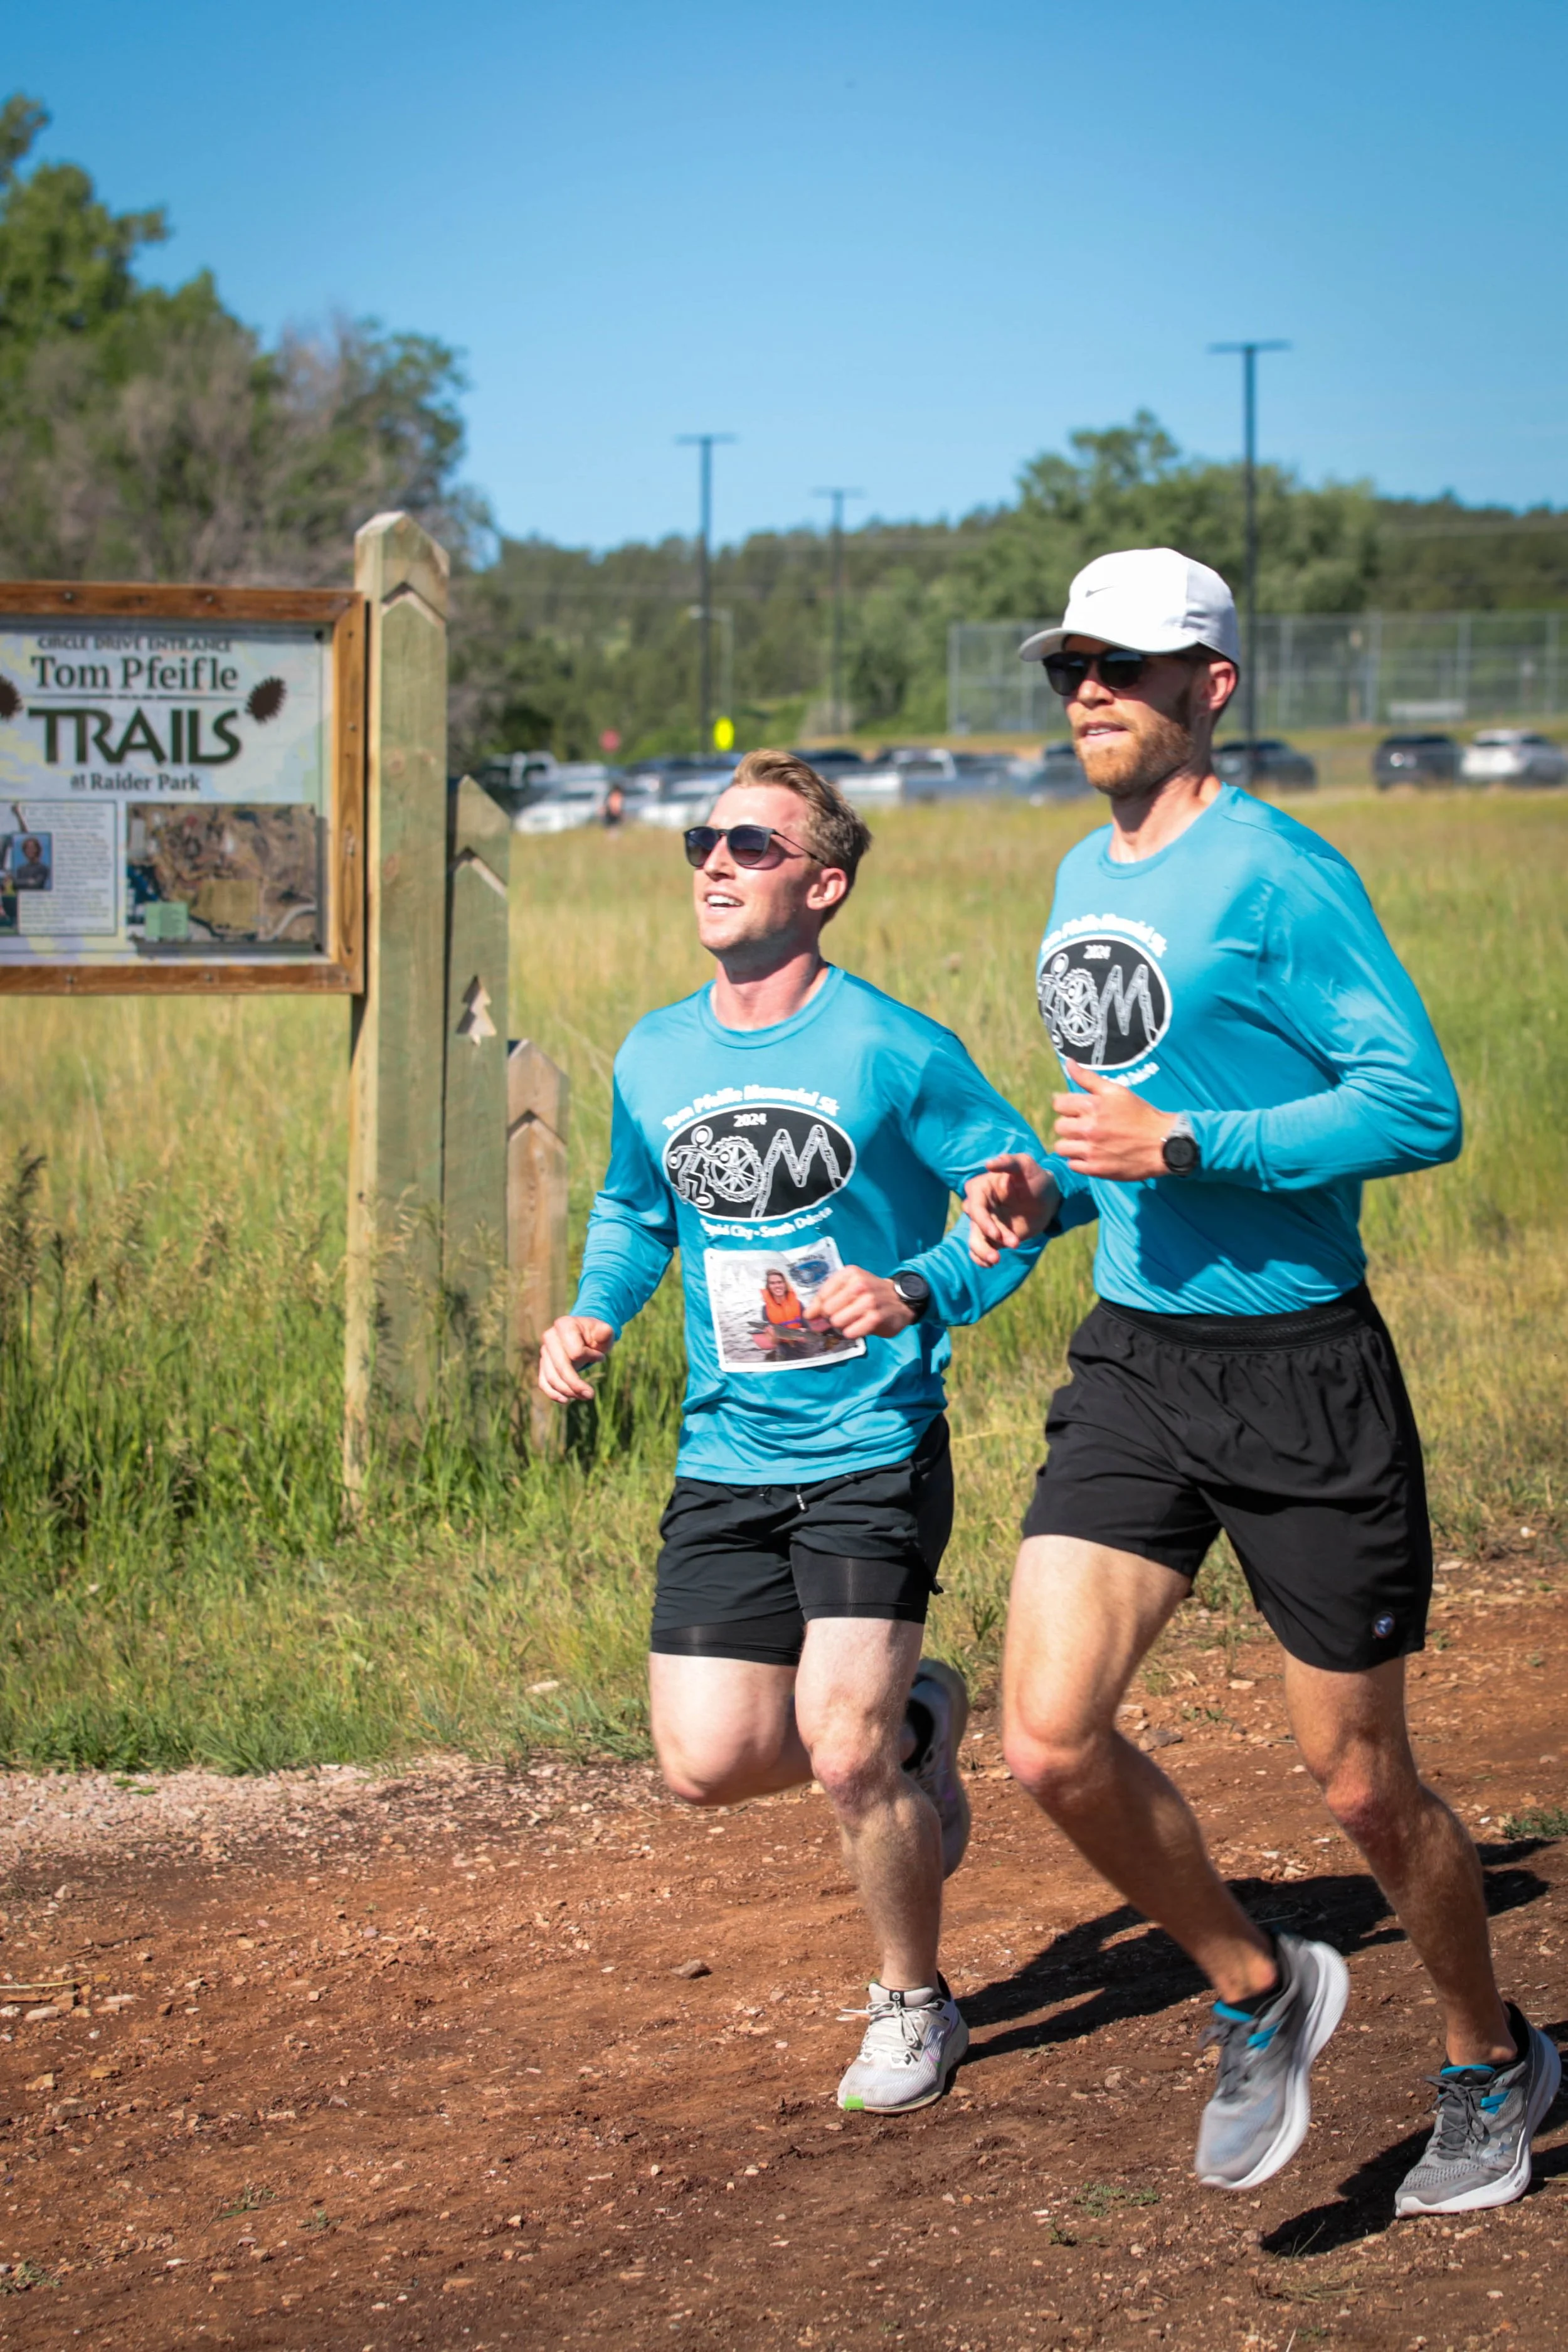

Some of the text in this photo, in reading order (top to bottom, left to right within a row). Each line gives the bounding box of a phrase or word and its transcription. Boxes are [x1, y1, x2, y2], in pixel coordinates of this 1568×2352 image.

[30, 654, 238, 691] Tom Pfeifle
[28, 706, 242, 765] TRAILS
[70, 772, 200, 791] at Raider Park
[733, 1113, 767, 1127] 2024
